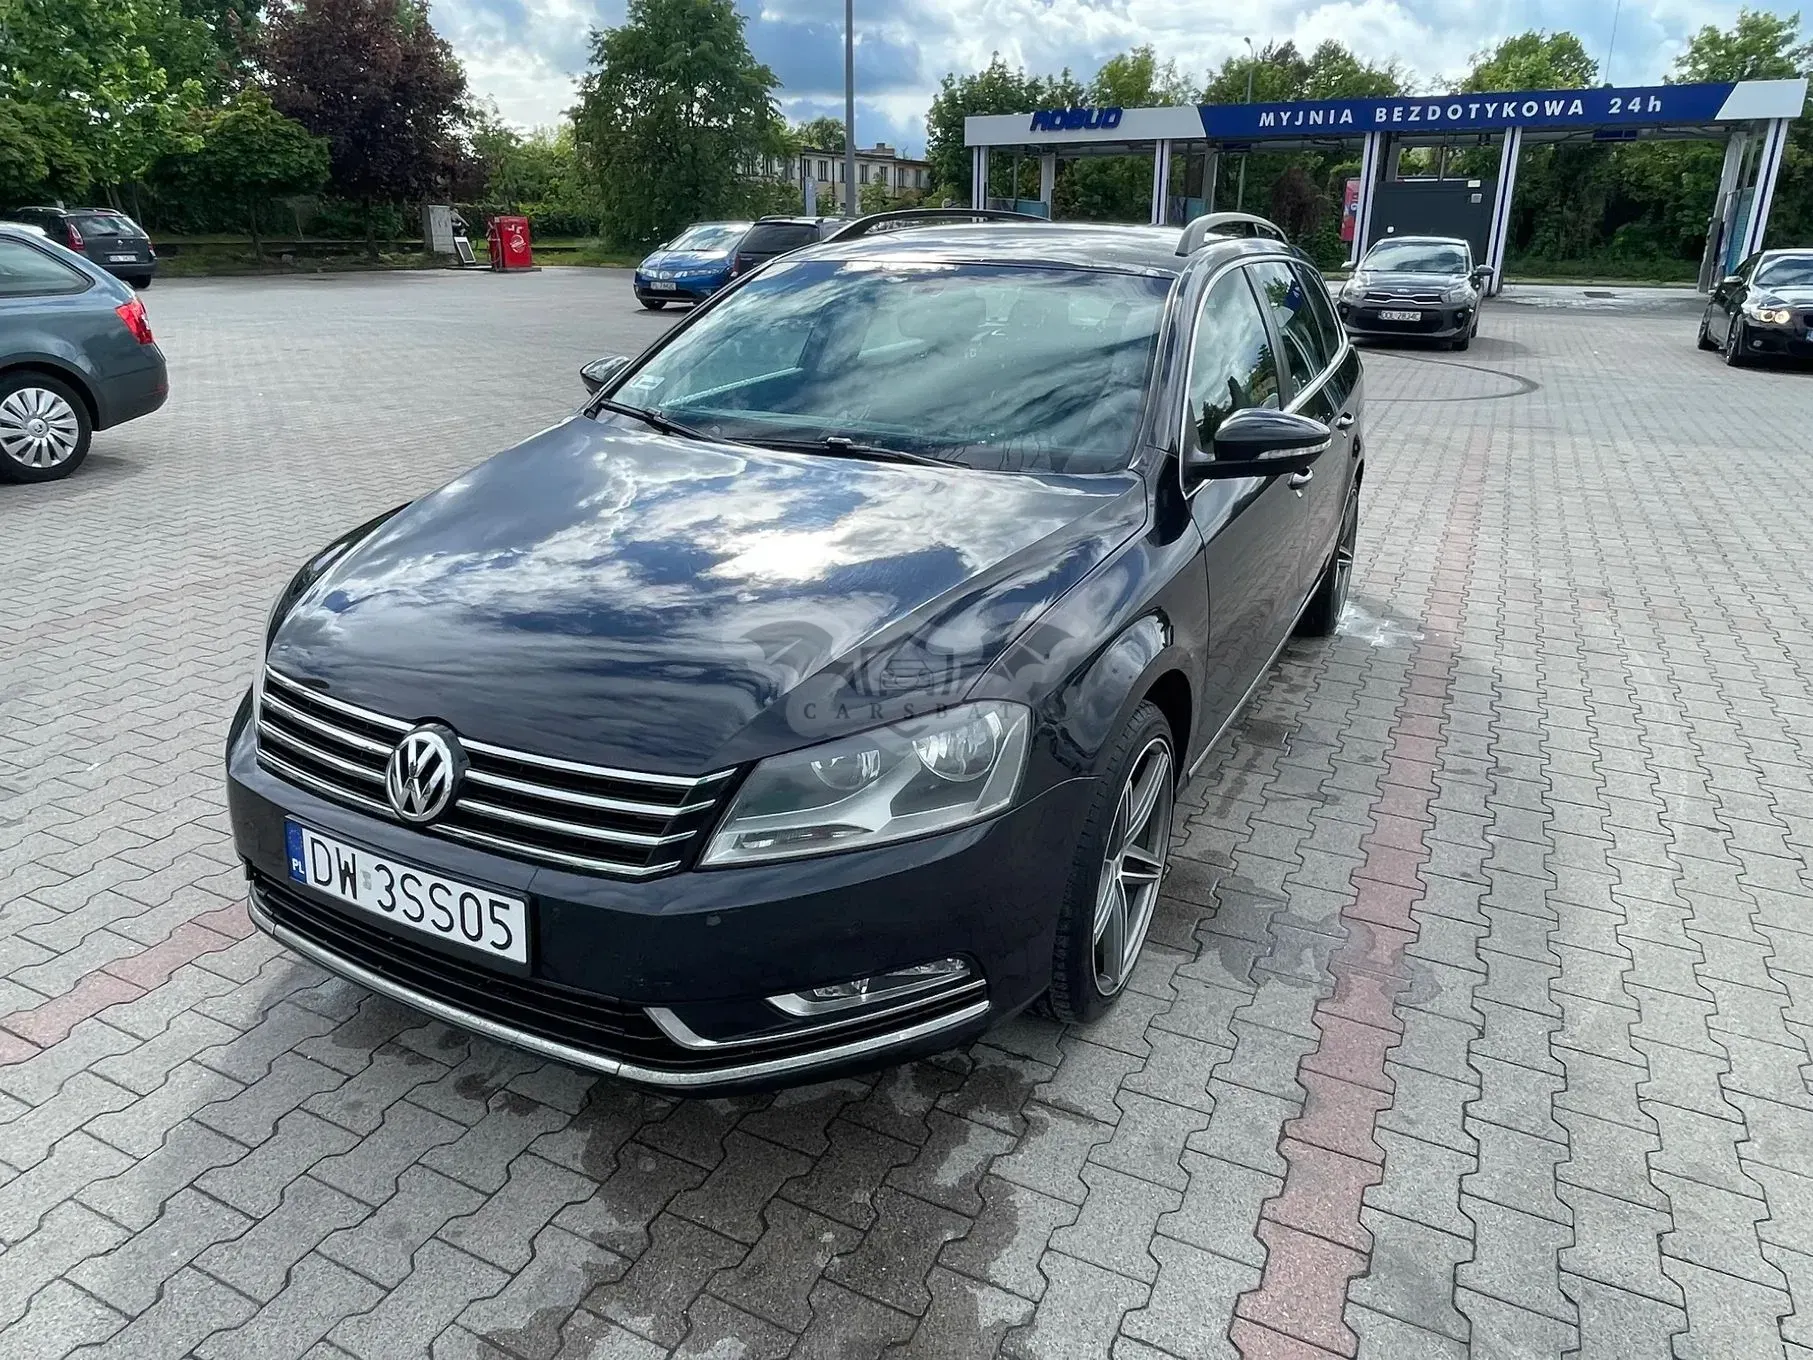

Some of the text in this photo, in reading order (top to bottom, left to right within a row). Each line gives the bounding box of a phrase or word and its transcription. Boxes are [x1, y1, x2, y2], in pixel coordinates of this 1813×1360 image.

[1258, 95, 1662, 127] MYJNIA BEZDOTYKOWA 24h
[291, 857, 305, 875] PL
[310, 836, 513, 950] DW 3SS05
